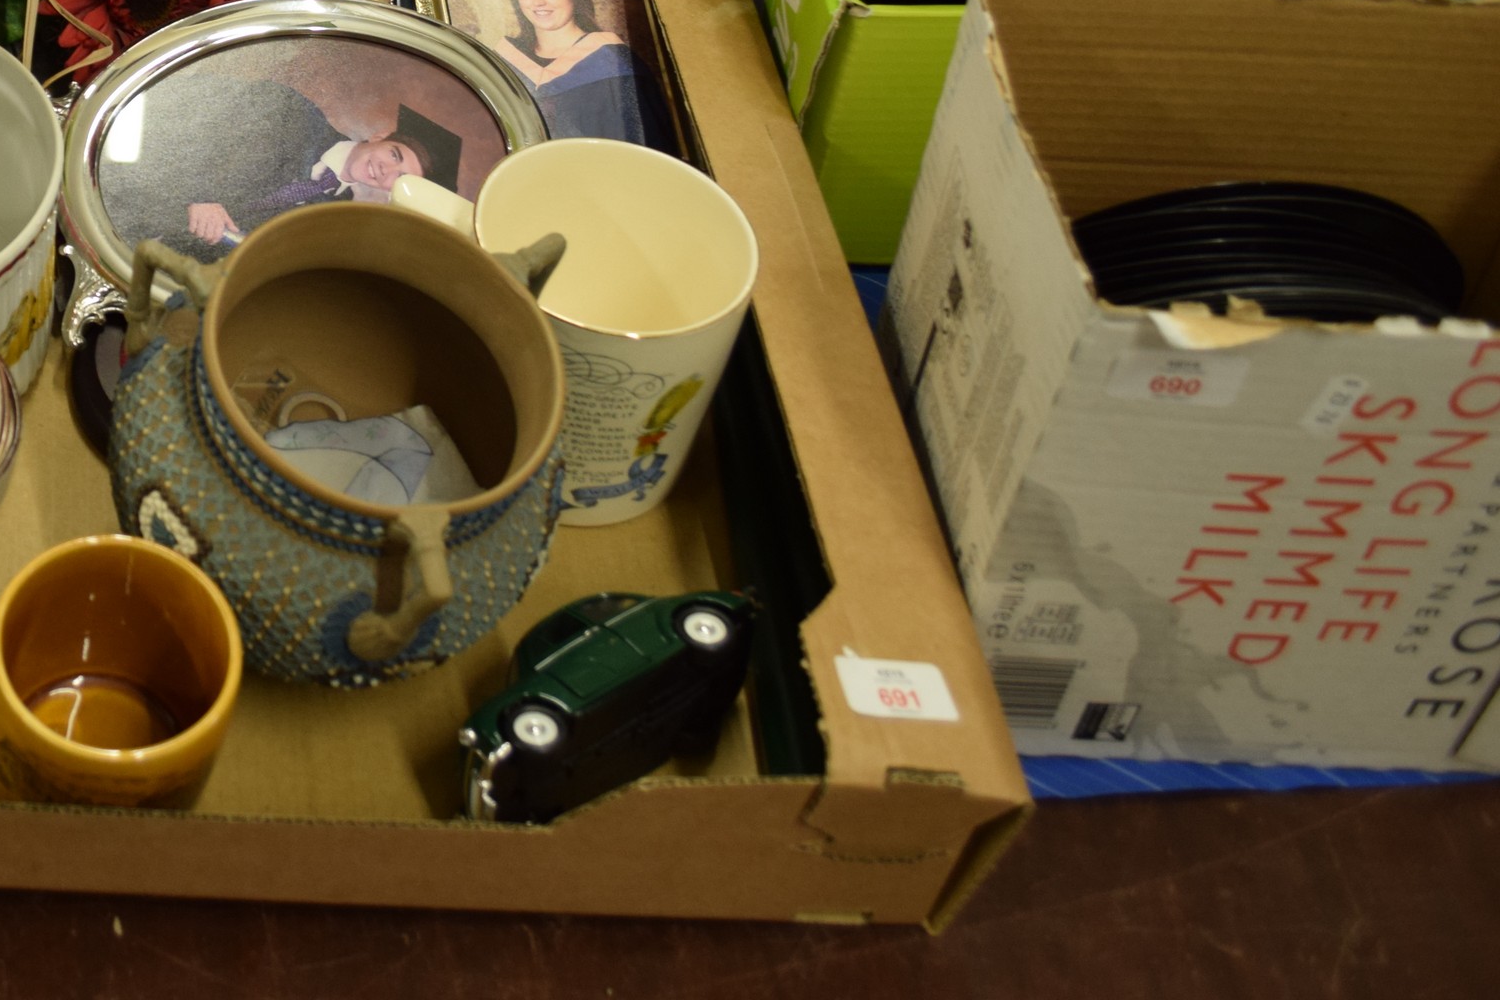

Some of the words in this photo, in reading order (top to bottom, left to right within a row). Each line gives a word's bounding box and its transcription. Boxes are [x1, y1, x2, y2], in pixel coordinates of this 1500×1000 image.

[1149, 375, 1204, 397] 690
[1168, 473, 1286, 607] MILK
[1227, 394, 1417, 665] SKIMMED
[1394, 502, 1500, 654] PARTNERS
[1316, 537, 1429, 643] LIFE
[878, 686, 921, 710] 691
